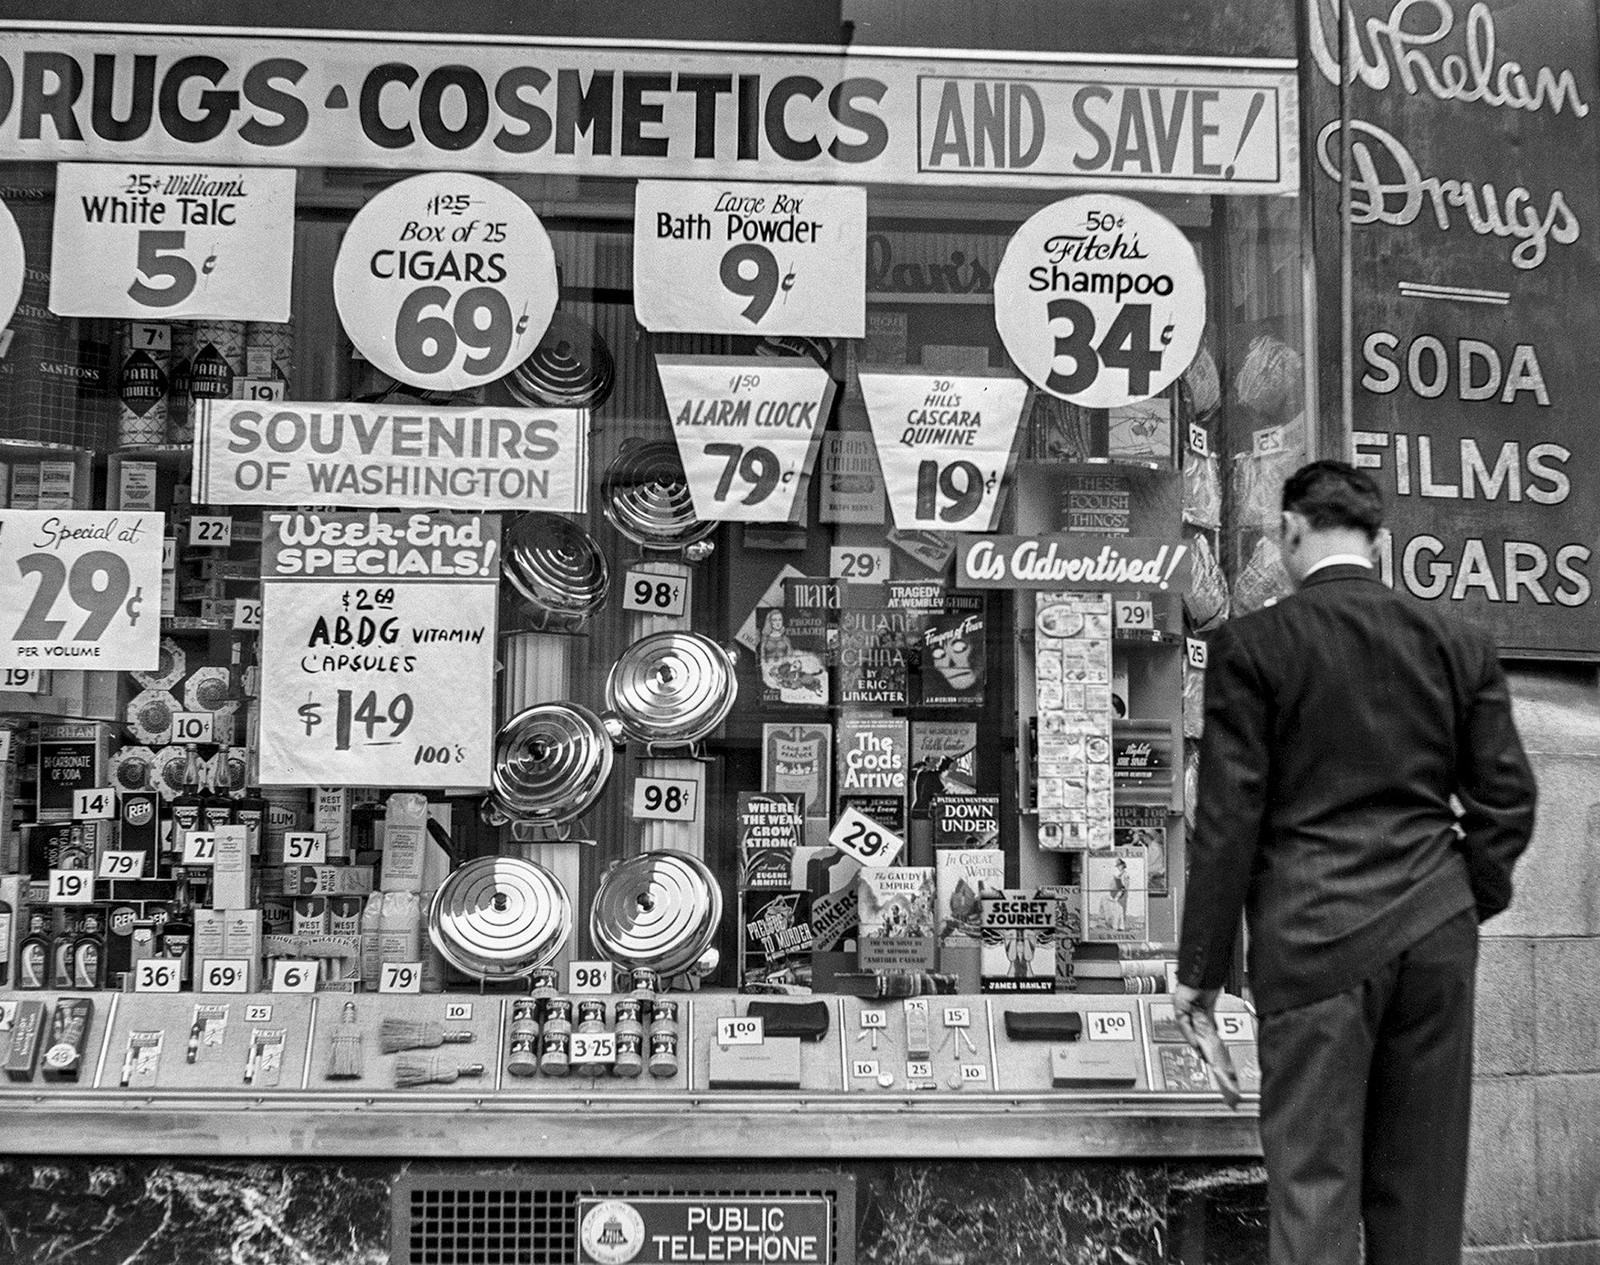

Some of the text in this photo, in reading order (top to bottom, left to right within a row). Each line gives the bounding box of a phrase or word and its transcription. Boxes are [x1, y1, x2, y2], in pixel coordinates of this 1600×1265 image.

[0, 50, 889, 164] RUGS COSMETICS
[928, 80, 1266, 180] AND SAVE!
[1316, 119, 1580, 269] Drugs
[81, 196, 237, 226] White Talc
[714, 192, 804, 217] Large Box
[400, 219, 508, 243] Box of 25
[657, 212, 823, 243] Bath Powder
[1084, 211, 1126, 231] 50¢
[1043, 232, 1150, 264] Fitch's
[127, 230, 218, 308] 5¢
[370, 250, 507, 283] CIGARS
[719, 243, 797, 325] 9¢
[1028, 265, 1174, 303] Shampoo
[395, 285, 530, 376] 69¢
[1045, 298, 1176, 396] 34¢
[192, 363, 228, 377] PARK
[1361, 331, 1551, 406] SODA
[923, 395, 962, 408] HILL'S
[676, 400, 818, 430] ALARM CLOCK
[906, 410, 982, 427] CASCARA
[228, 410, 560, 460] SOUVENIRS
[900, 428, 977, 447] QUININE
[703, 442, 796, 505] 79¢
[1351, 431, 1571, 504] FILMS
[235, 461, 550, 499] OF WASHINGTON
[915, 459, 997, 523] 19¢
[1070, 496, 1129, 509] FOOLISH
[33, 517, 146, 550] Special at
[198, 521, 230, 541] 22¢
[270, 513, 483, 545] Week-End
[276, 540, 497, 577] SPECIALS!
[839, 553, 882, 577] 29¢
[965, 540, 1187, 590] As Advertised!
[1376, 528, 1592, 606] IGARS
[12, 550, 144, 642] 29¢
[633, 580, 679, 608] 98¢
[890, 586, 941, 598] TRAGEDY
[887, 598, 899, 608] AT
[900, 598, 945, 608] WEMBLEY
[413, 626, 486, 645] VITAMIN
[17, 646, 101, 658] PER VOLUME
[302, 655, 417, 674] CAPSULES
[857, 679, 888, 690] ERIC
[842, 691, 905, 702] LINKLATER
[176, 718, 210, 738] 10¢
[855, 732, 894, 752] The
[414, 743, 466, 765] 100's
[846, 750, 903, 770] Gods
[844, 767, 905, 788] Arrive
[80, 795, 109, 815] 14¢
[319, 796, 342, 804] WEST
[644, 784, 689, 813] 98¢
[747, 802, 795, 813] WHERE
[127, 802, 152, 819] REM
[319, 805, 342, 813] POINT
[944, 804, 994, 818] DOWN
[741, 814, 803, 825] THE WEAK
[941, 819, 998, 832] UNDER
[751, 826, 793, 837] GROW
[842, 821, 890, 858] 29¢
[289, 837, 320, 859] 57¢
[746, 838, 798, 848] STRONG
[107, 856, 139, 874] 79¢
[57, 875, 89, 896] 19¢
[879, 881, 915, 890] EMPIRE
[887, 872, 920, 881] GAUDY
[992, 902, 1048, 913] SECRET
[299, 921, 321, 929] WEST
[334, 921, 356, 929] WEST
[986, 913, 1053, 925] JOURNEY
[775, 922, 813, 950] MURDER
[142, 966, 176, 987] 36¢
[209, 967, 243, 987] 69¢
[284, 967, 309, 988] 6¢
[386, 968, 418, 988] 79¢
[576, 968, 607, 987] 98¢
[988, 982, 1053, 990] JAMES HANLEY
[251, 1008, 267, 1019] 25
[913, 1064, 928, 1075] 25
[687, 1206, 785, 1232] PUBLIC
[651, 1235, 818, 1262] TELEPHONE
